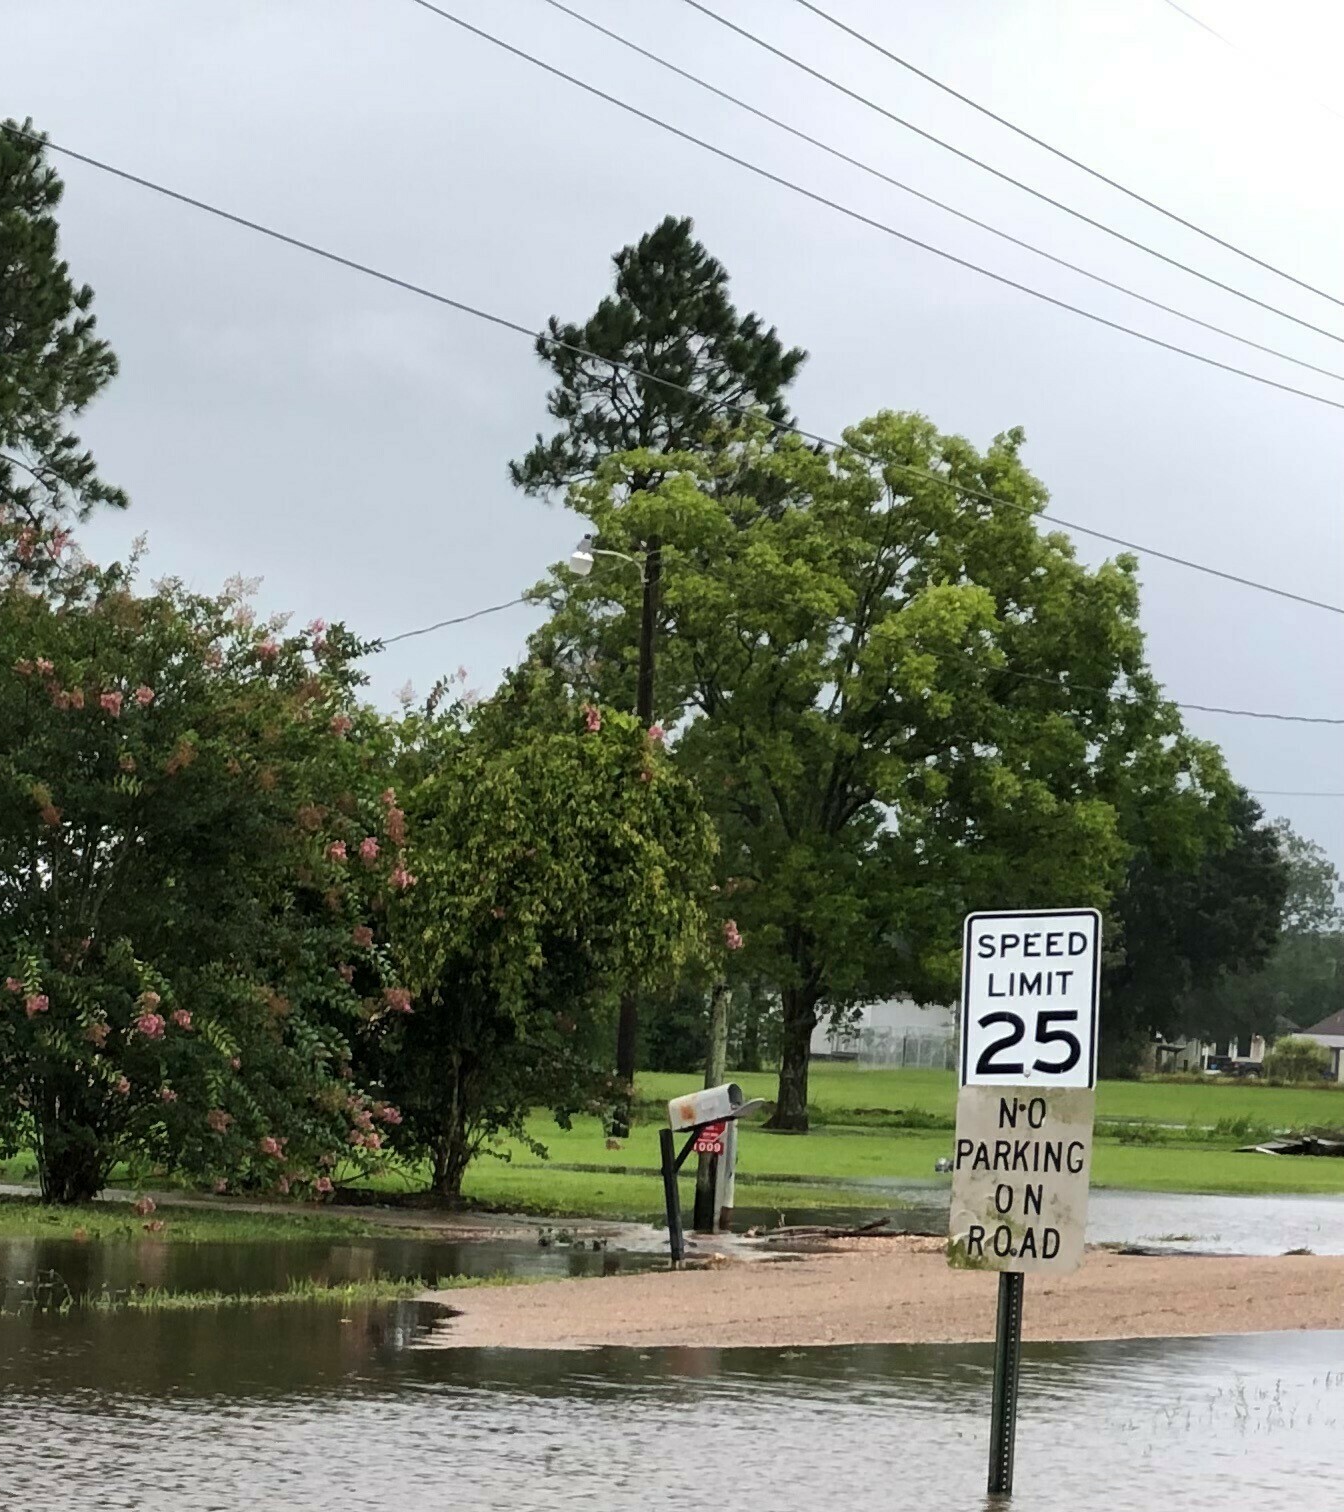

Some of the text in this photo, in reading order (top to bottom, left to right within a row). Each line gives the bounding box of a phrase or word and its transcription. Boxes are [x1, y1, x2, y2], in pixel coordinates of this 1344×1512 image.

[977, 931, 1088, 959] SPEED
[988, 970, 1074, 997] LIMIT
[975, 1009, 1082, 1075] 25
[998, 1097, 1047, 1129] NO
[956, 1138, 1085, 1174] PARKING
[995, 1183, 1044, 1216] ON
[967, 1224, 1061, 1260] ROAD
